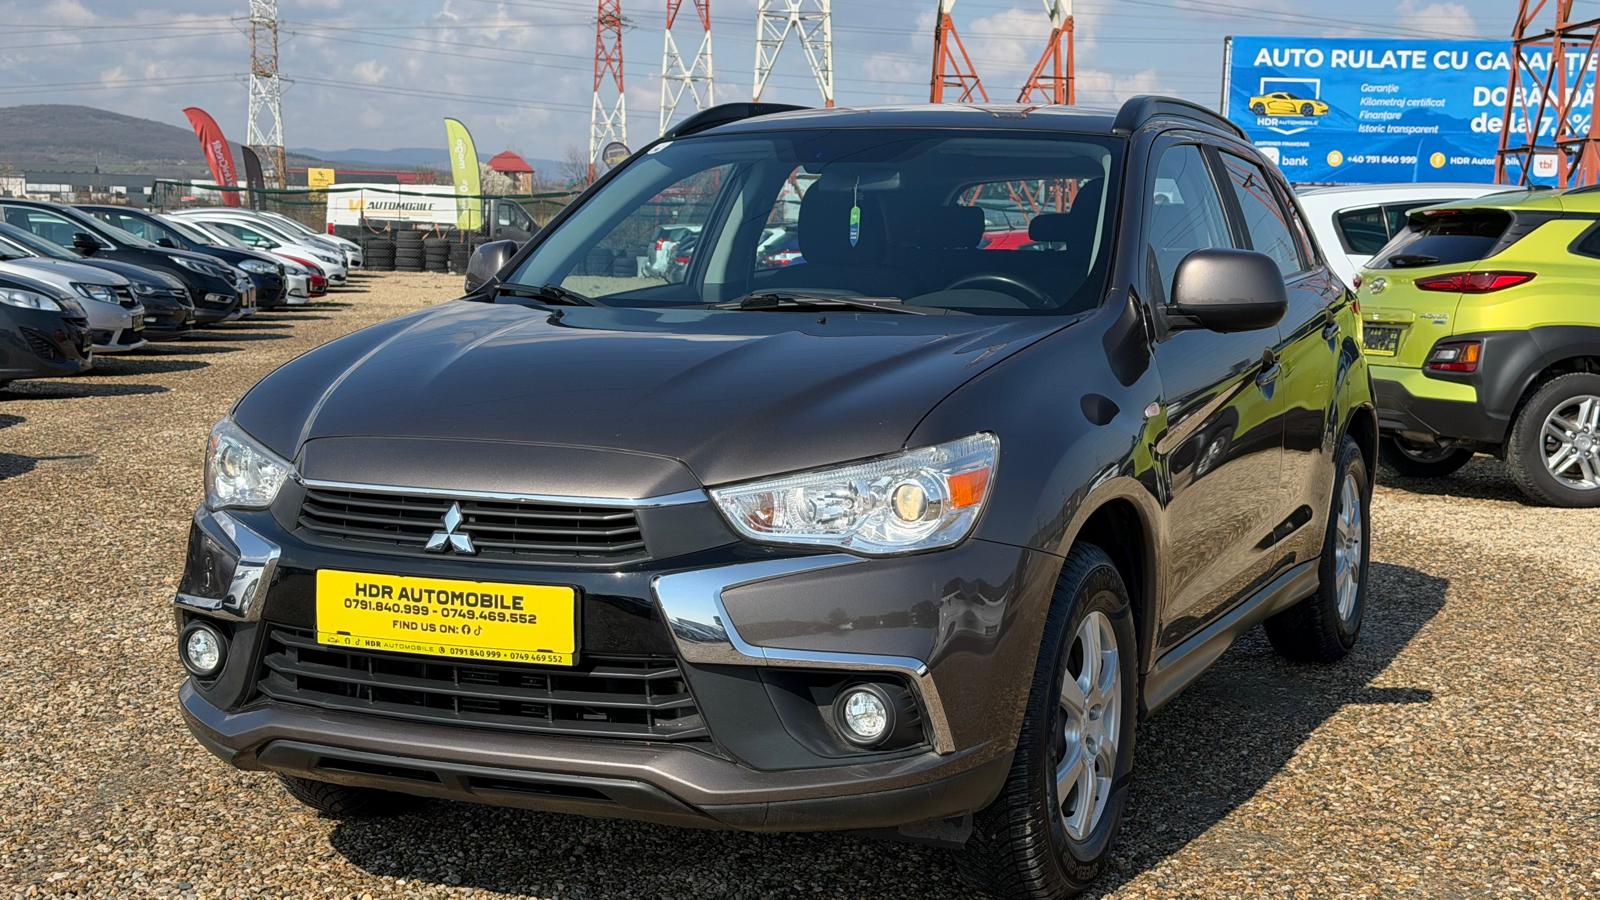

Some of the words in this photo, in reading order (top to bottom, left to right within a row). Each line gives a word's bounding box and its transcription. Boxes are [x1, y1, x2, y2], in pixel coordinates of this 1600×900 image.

[1254, 48, 1324, 68] AUTO
[1331, 50, 1427, 69] RULATE
[1433, 51, 1468, 70] CU
[1360, 97, 1406, 108] Kilometraj
[1406, 98, 1446, 107] certificat
[1257, 117, 1278, 126] HDR
[1471, 112, 1503, 133] de
[1509, 112, 1531, 133] la
[1538, 114, 1591, 137] 7,%
[1358, 123, 1386, 133] Istoric
[1387, 124, 1439, 135] transparent
[1282, 155, 1309, 166] bank
[1347, 155, 1364, 164] +40
[1365, 155, 1380, 164] 791
[1381, 155, 1399, 165] 840
[1400, 156, 1418, 165] 999
[1450, 156, 1470, 165] HDR
[1471, 156, 1522, 166] Autobil
[1539, 160, 1553, 169] tbi
[355, 582, 393, 599] HDR
[398, 587, 524, 610] AUTOMOBILE
[344, 598, 429, 616] 0791.840.999
[441, 608, 537, 624] 0749.469.552
[392, 620, 418, 631] FIND
[421, 622, 437, 632] US
[439, 624, 459, 634] ON:
[365, 639, 381, 648] HDR
[383, 643, 434, 652] AUTOMOBILE
[449, 648, 468, 656] 0791
[469, 649, 485, 657] 840
[486, 650, 501, 659] 999
[510, 652, 529, 661] 0749
[531, 653, 546, 662] 469
[547, 655, 563, 663] 552
